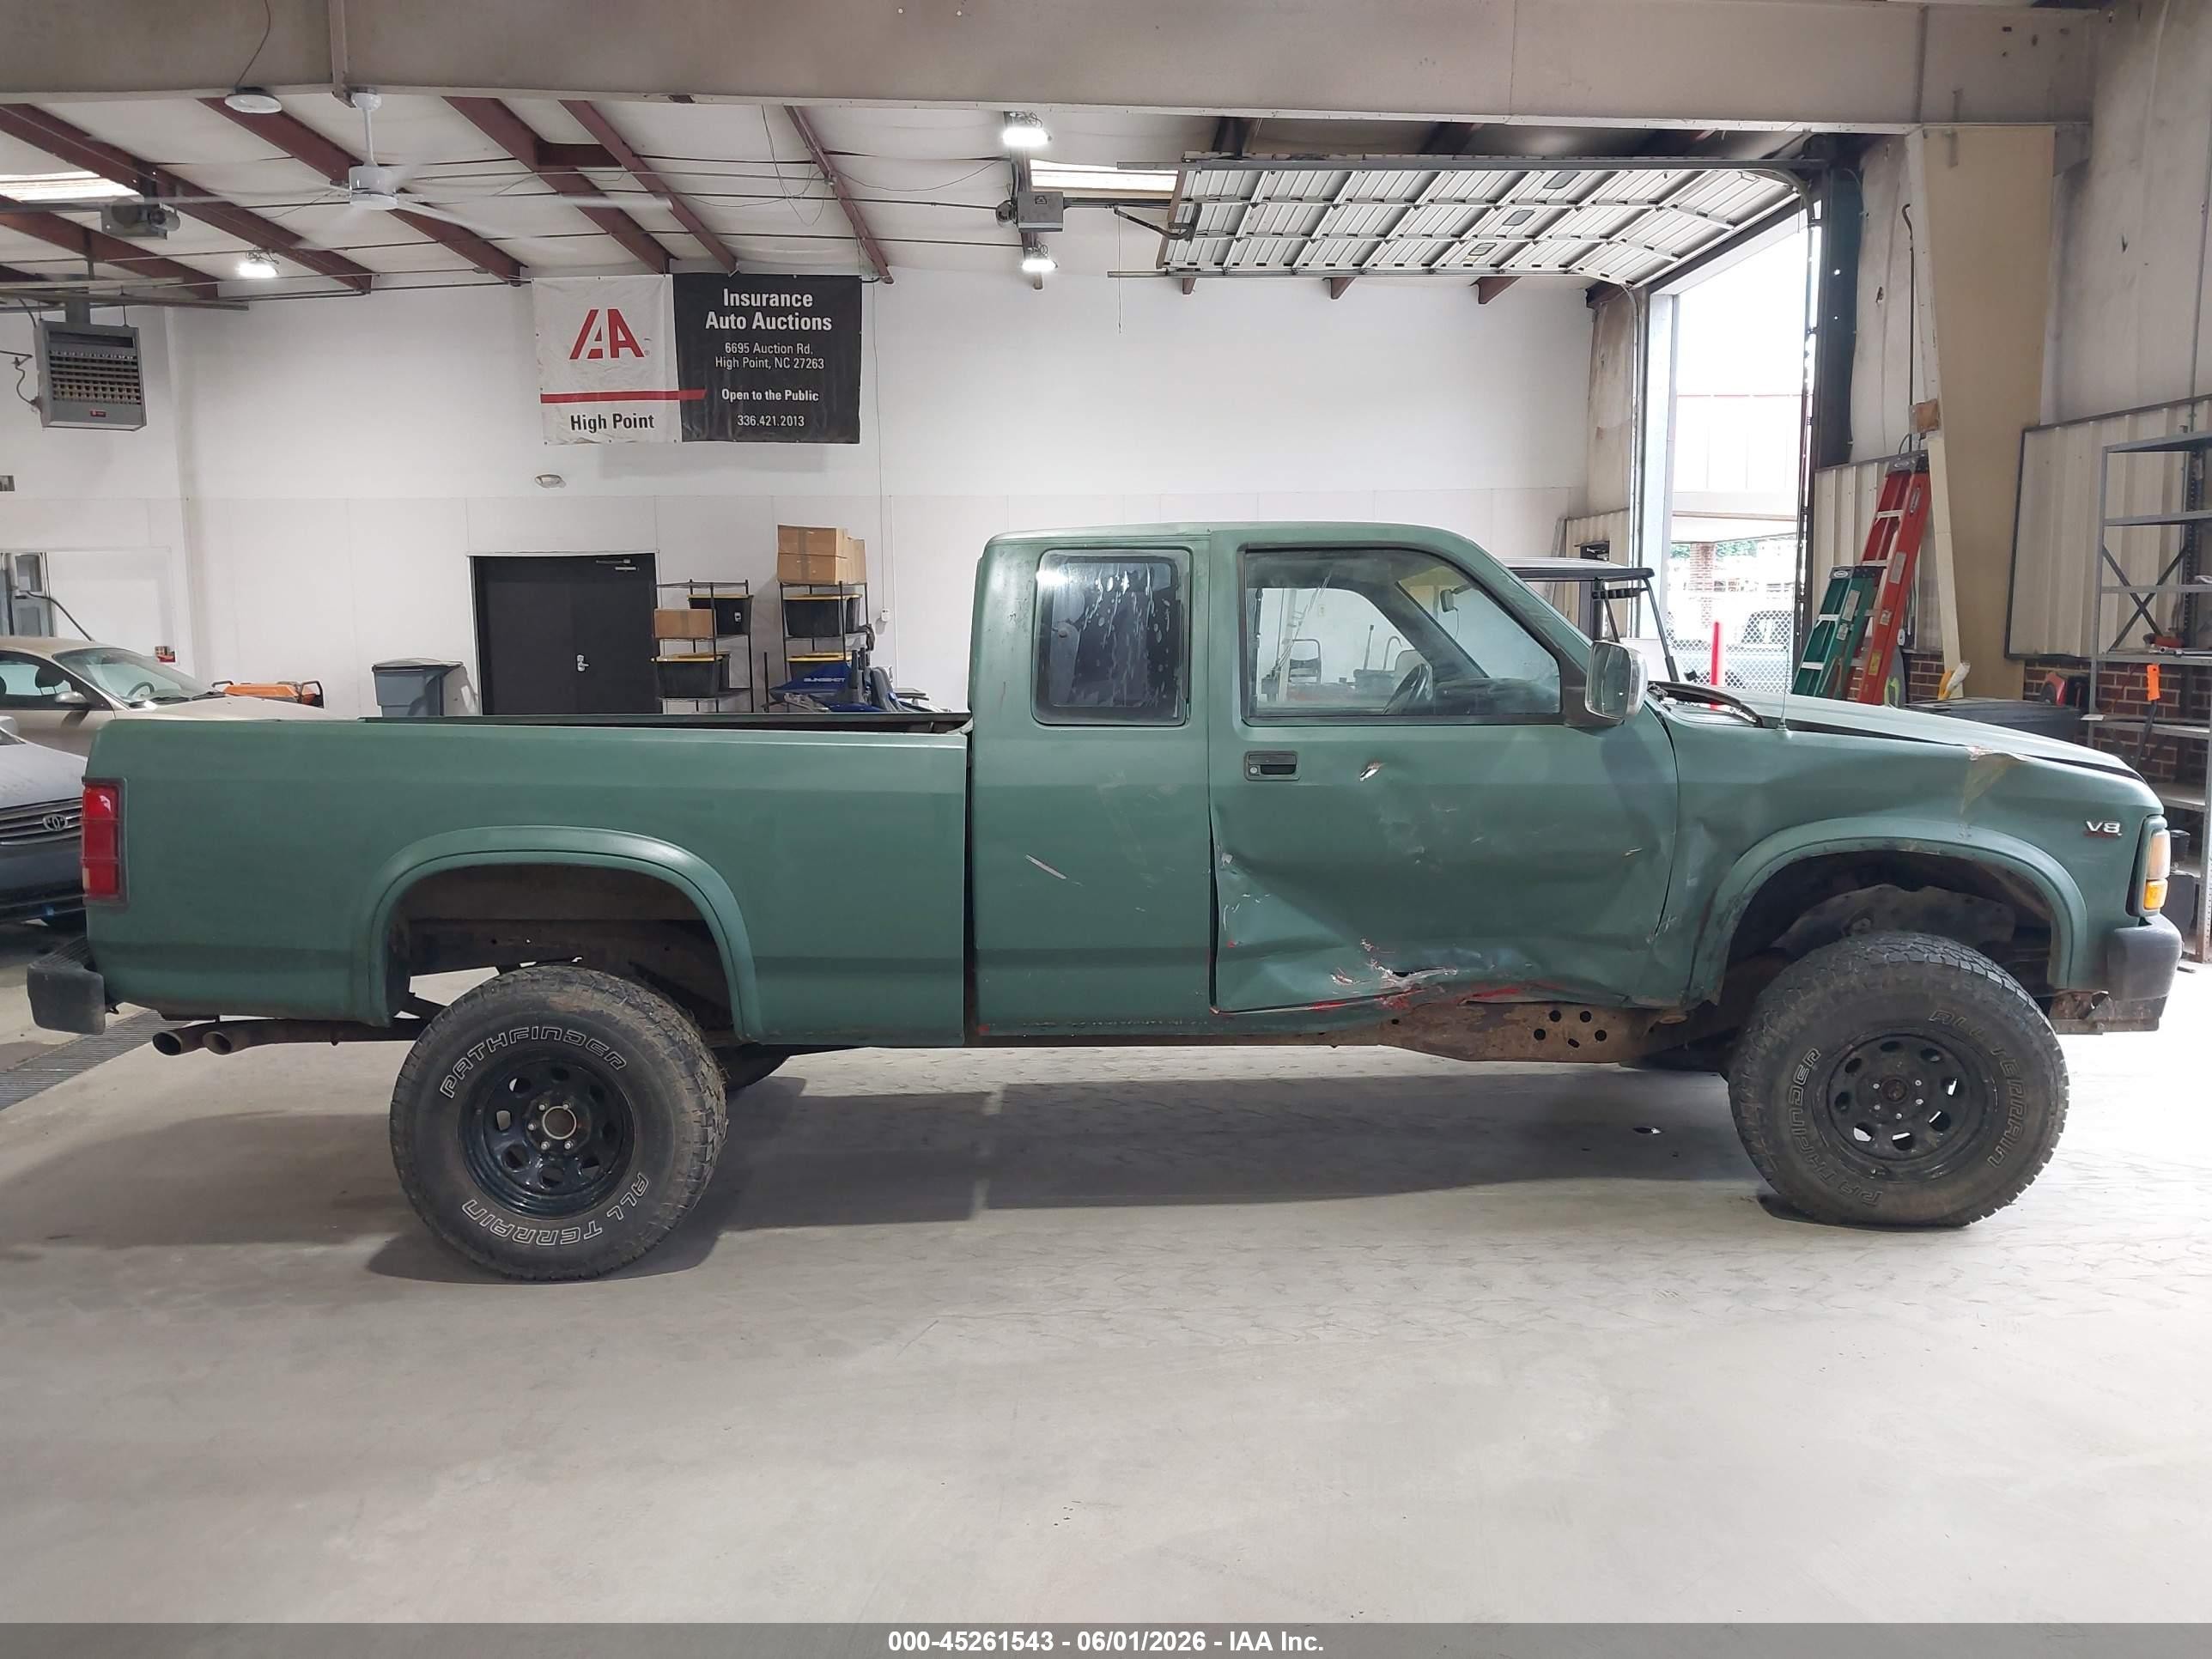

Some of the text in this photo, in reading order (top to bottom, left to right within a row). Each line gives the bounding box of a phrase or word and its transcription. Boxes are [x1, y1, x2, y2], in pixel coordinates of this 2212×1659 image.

[723, 288, 813, 307] Insurance
[705, 311, 832, 331] Auto Auctions
[725, 343, 814, 355] 6695 Auction Rd.
[715, 356, 824, 370] High Point, NC 27263
[721, 388, 819, 403] Open to the Public
[570, 412, 655, 434] High Point
[737, 415, 805, 427] 336.421.2013
[2087, 821, 2121, 833] V8
[440, 1026, 628, 1099] PATHFINDER
[461, 1173, 650, 1246] ALL TERRAIN
